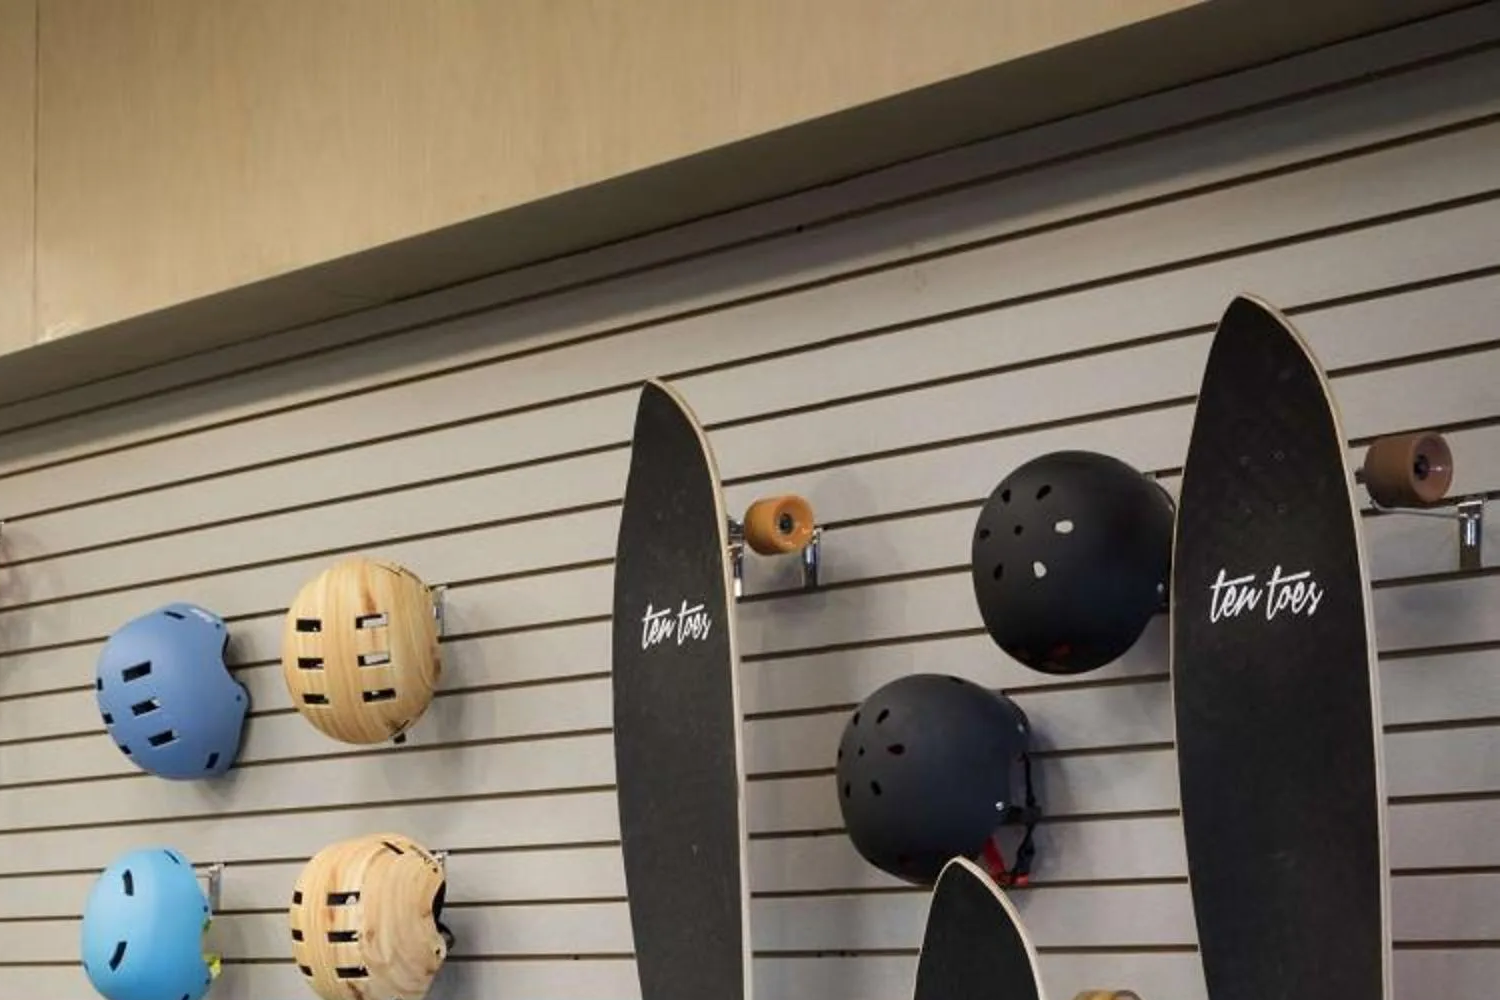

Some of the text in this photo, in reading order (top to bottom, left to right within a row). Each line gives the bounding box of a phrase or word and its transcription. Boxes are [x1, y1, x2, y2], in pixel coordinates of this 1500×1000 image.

[1210, 564, 1323, 623] ten toes
[641, 599, 712, 649] ten toes
